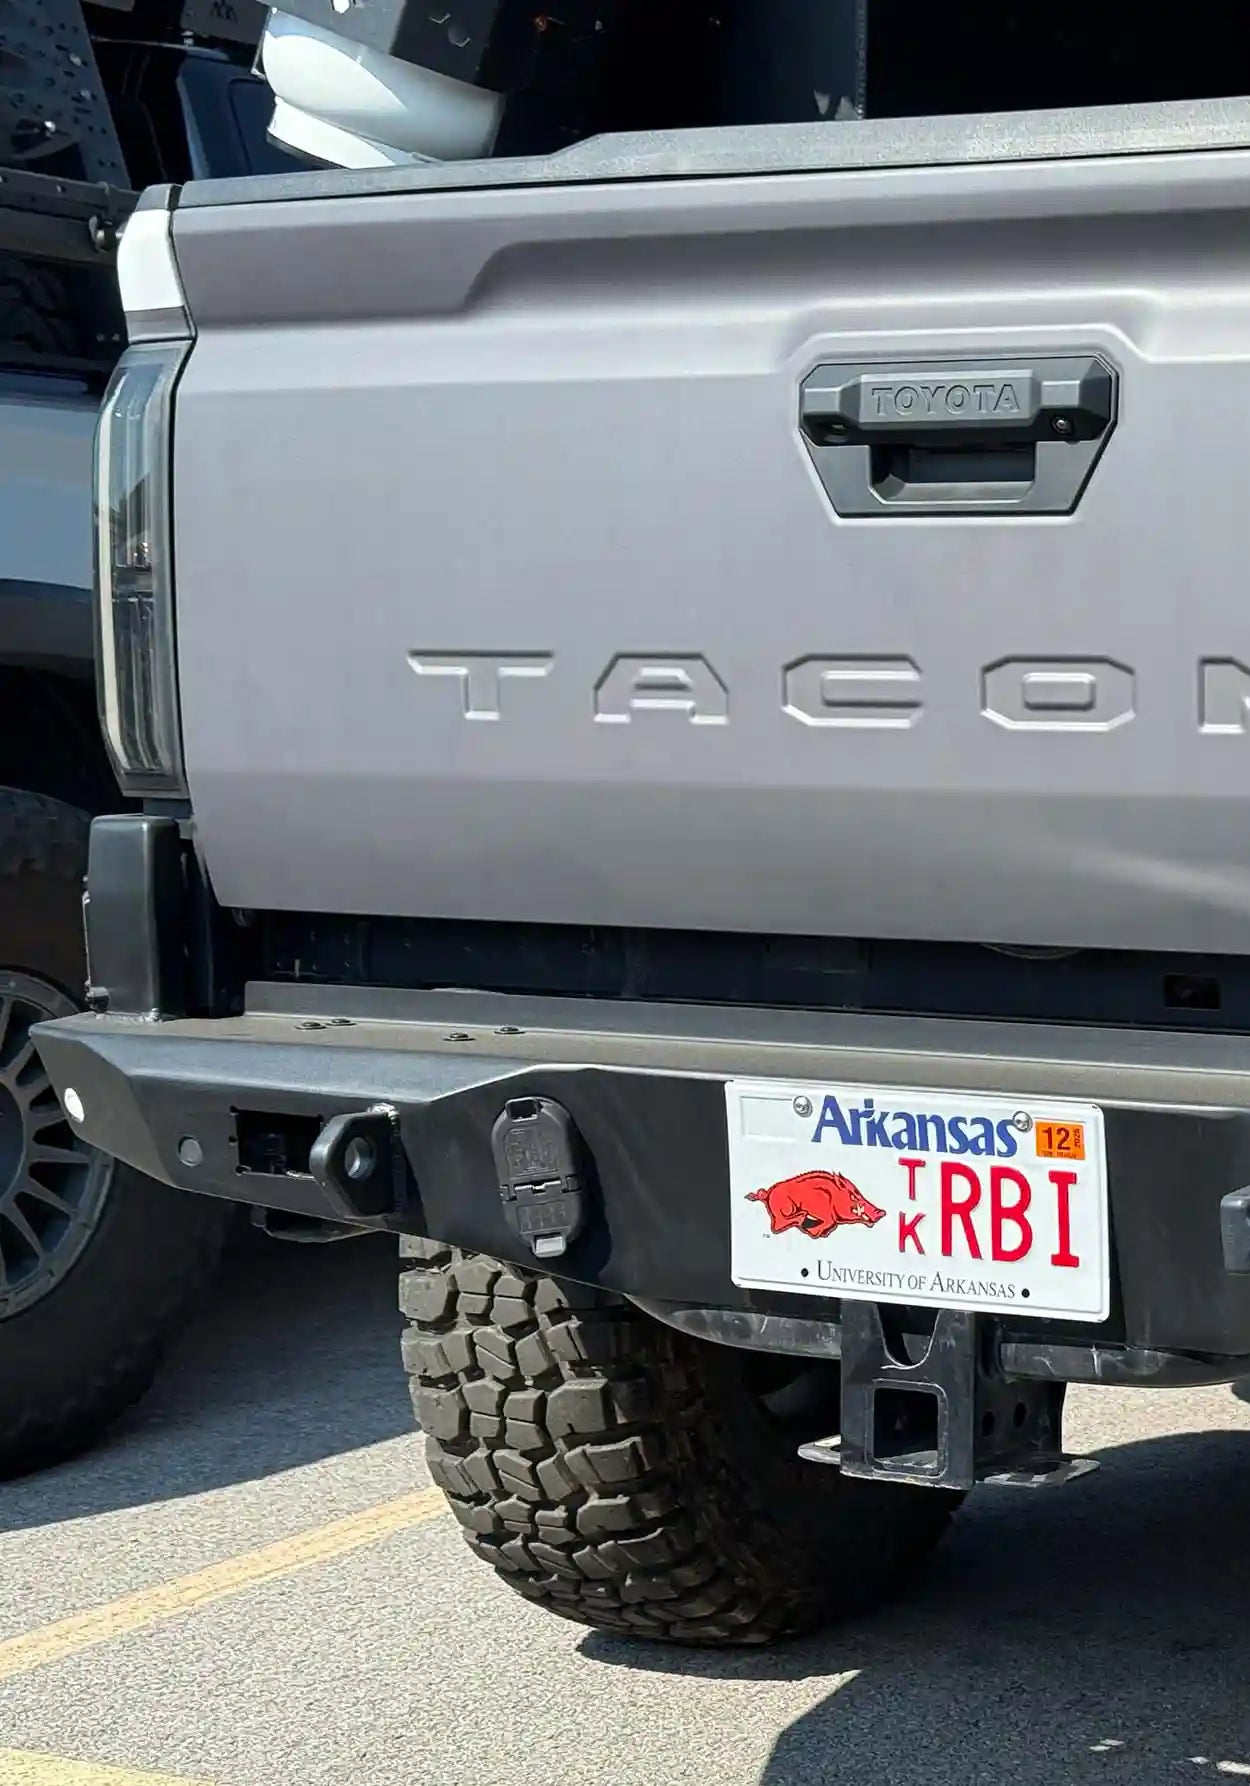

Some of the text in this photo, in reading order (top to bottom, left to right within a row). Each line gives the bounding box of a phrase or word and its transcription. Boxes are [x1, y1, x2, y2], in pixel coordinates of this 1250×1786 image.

[872, 384, 1020, 417] TOYOTA
[811, 1094, 1018, 1158] Arkansas
[1042, 1126, 1071, 1150] 12
[941, 1161, 1080, 1268] RBI
[816, 1259, 1016, 1299] UNIVERSITY OF ARKANSAS
